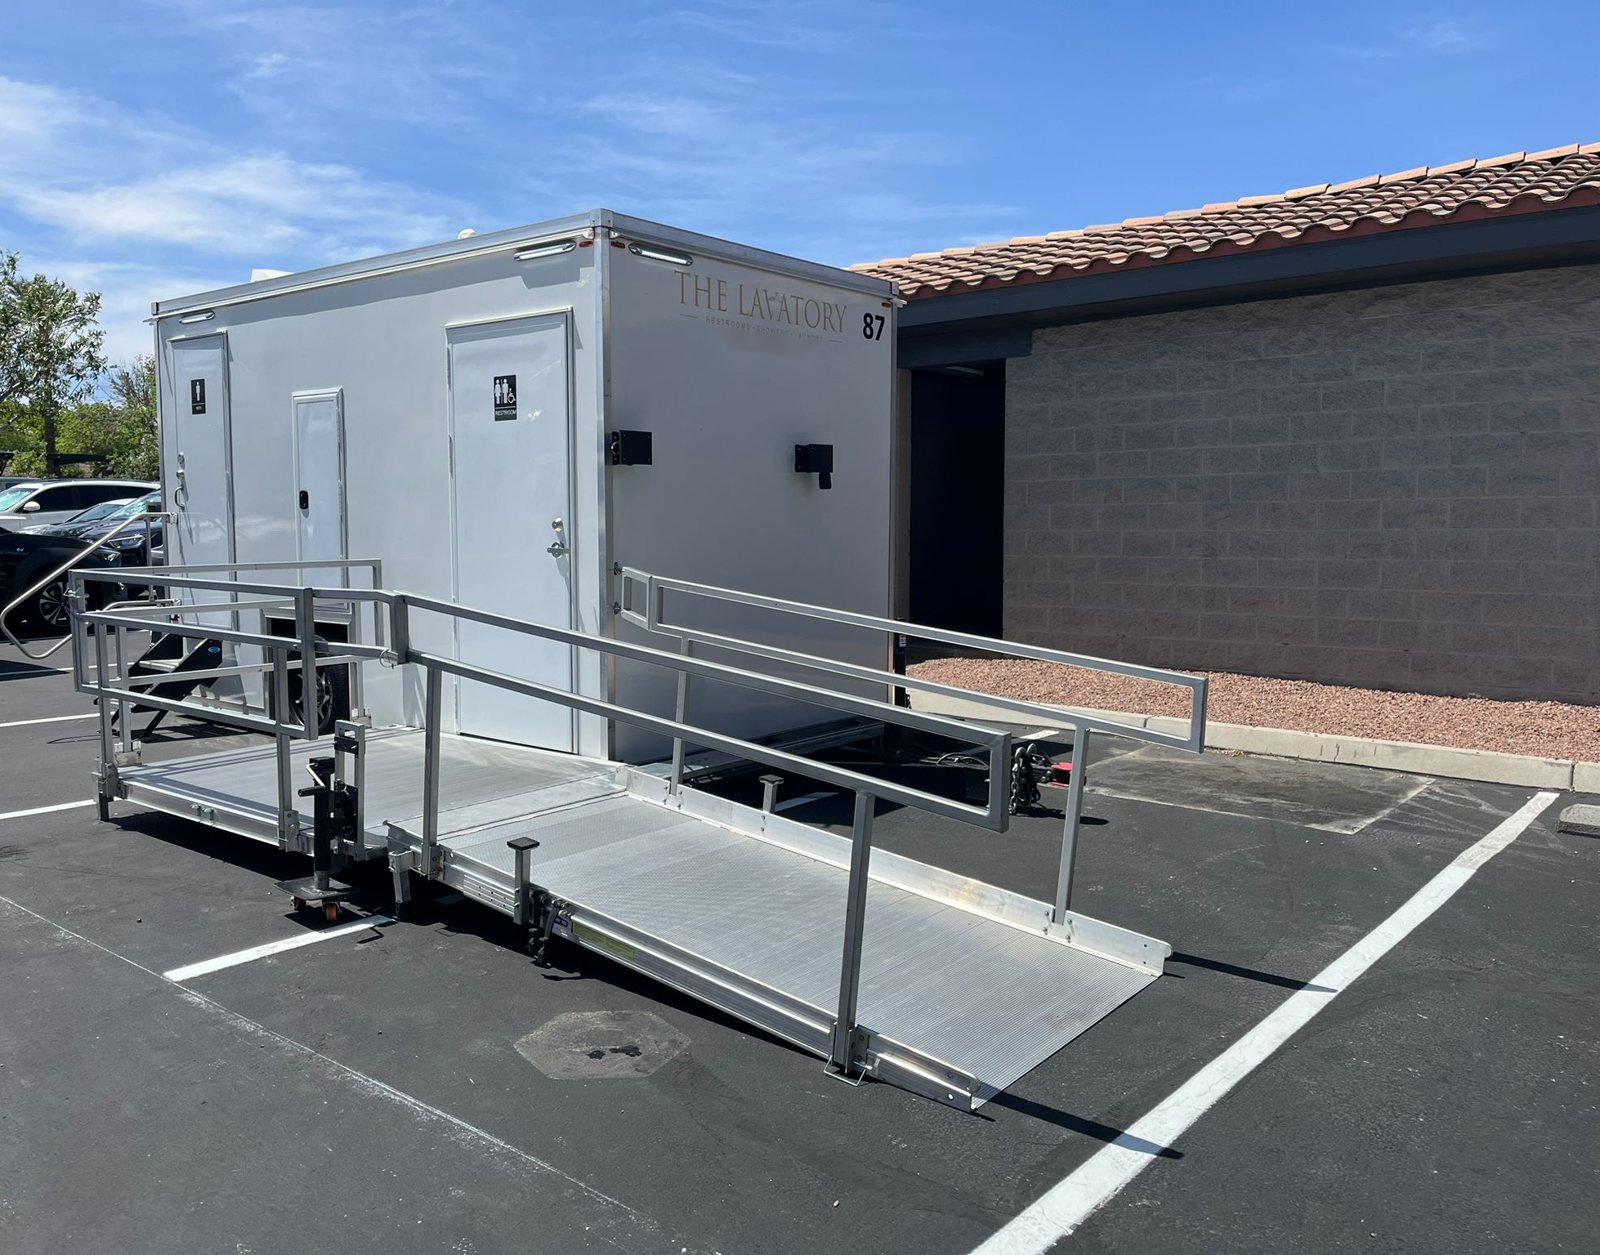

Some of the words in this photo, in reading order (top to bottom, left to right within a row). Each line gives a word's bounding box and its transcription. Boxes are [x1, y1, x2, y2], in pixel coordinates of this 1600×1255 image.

[674, 271, 727, 312] THE
[738, 284, 847, 332] LAVATORY
[706, 315, 749, 330] RESTROOMS
[863, 312, 885, 341] 87
